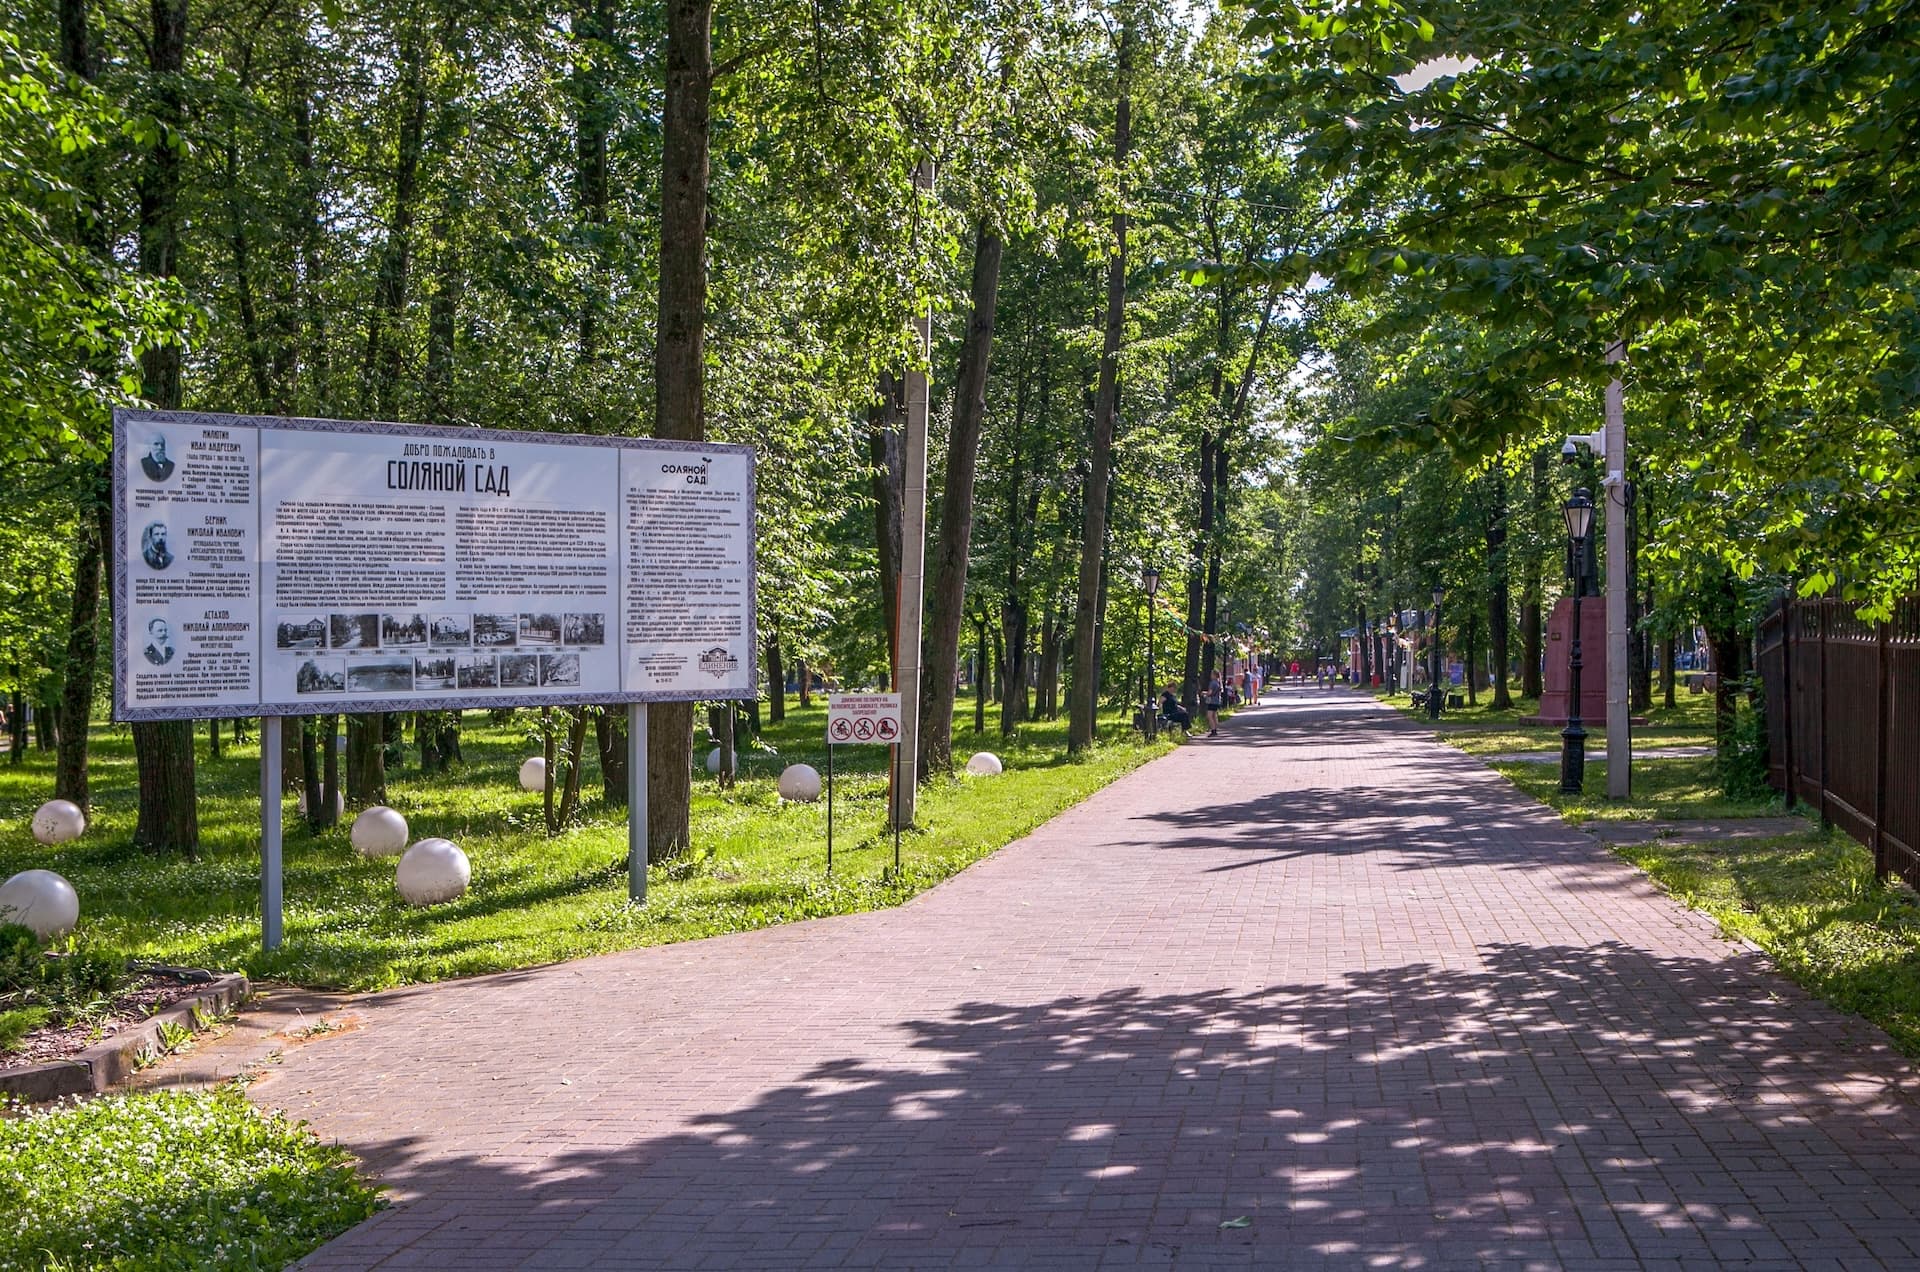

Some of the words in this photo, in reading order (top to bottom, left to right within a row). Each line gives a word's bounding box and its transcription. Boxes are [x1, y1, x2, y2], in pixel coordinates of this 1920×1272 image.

[203, 430, 229, 439] МИЛЮТИН
[191, 441, 206, 451] ИВАН
[209, 442, 241, 452] АНДРЕЕВИЧ
[404, 444, 429, 456] ДОБРО
[433, 445, 486, 459] ПОЖАЛОВАТЬ
[490, 448, 495, 459] В
[662, 465, 705, 474] СОЛЯНОЙ
[388, 460, 465, 492] СОЛЯНОЙ
[475, 465, 510, 496] САД
[687, 476, 705, 485] САД
[205, 516, 226, 525] БЕРНИК
[188, 528, 214, 537] НИКОЛАЙ
[216, 529, 245, 538] ИВАНОВИЧ
[204, 610, 229, 619] АСТАХОВ
[183, 622, 209, 631] НИКОЛАЙ
[212, 623, 250, 631] АПОЛЛОНОВИЧ
